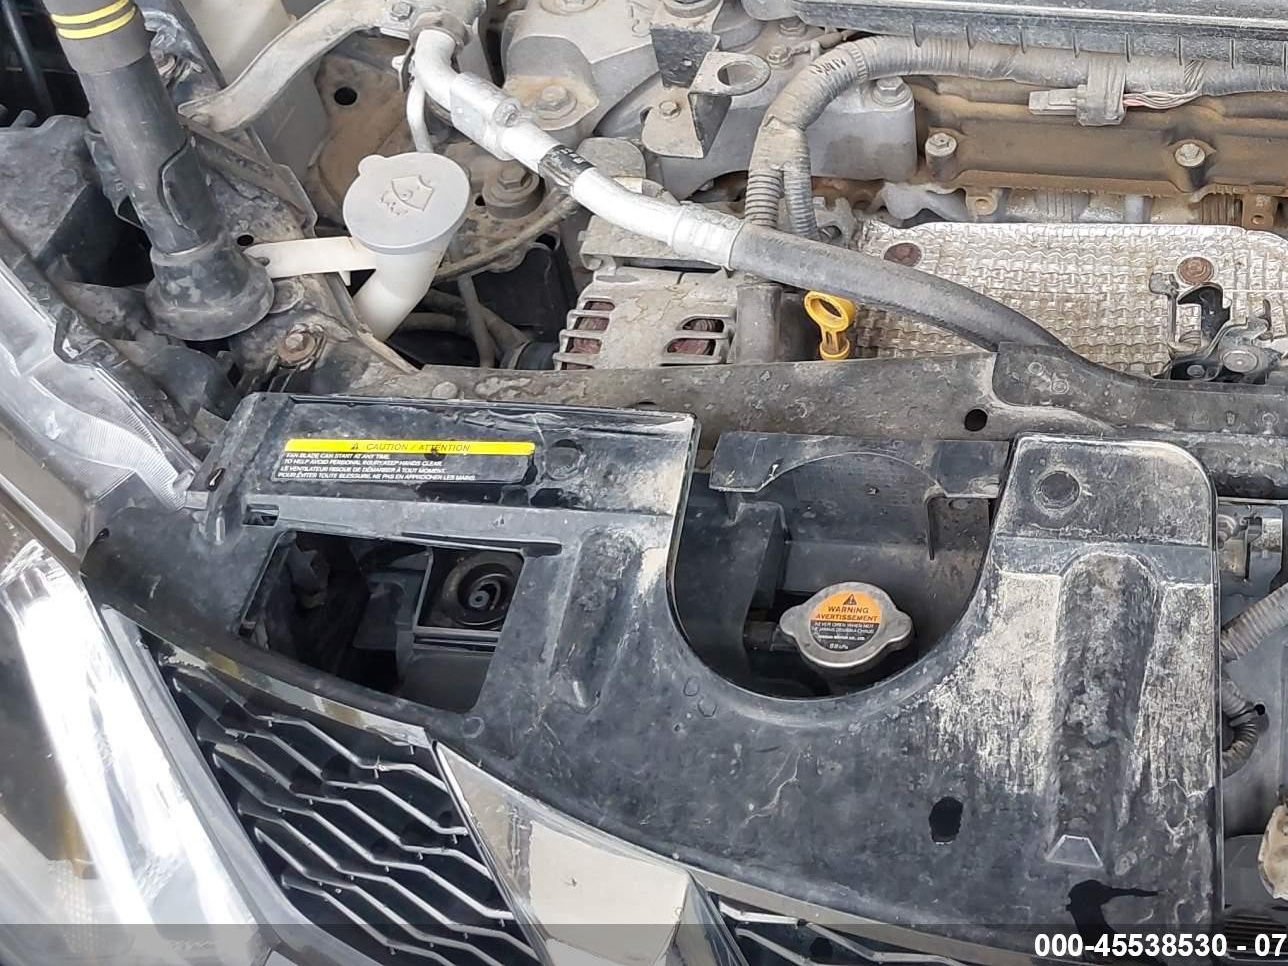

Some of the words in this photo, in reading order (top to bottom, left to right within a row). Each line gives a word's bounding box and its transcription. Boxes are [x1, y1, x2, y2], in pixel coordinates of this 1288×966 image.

[366, 442, 409, 451] CAUTION
[419, 444, 471, 452] ATTENTION
[828, 606, 869, 614] WARNING
[815, 613, 878, 622] AVERTISSEMENT
